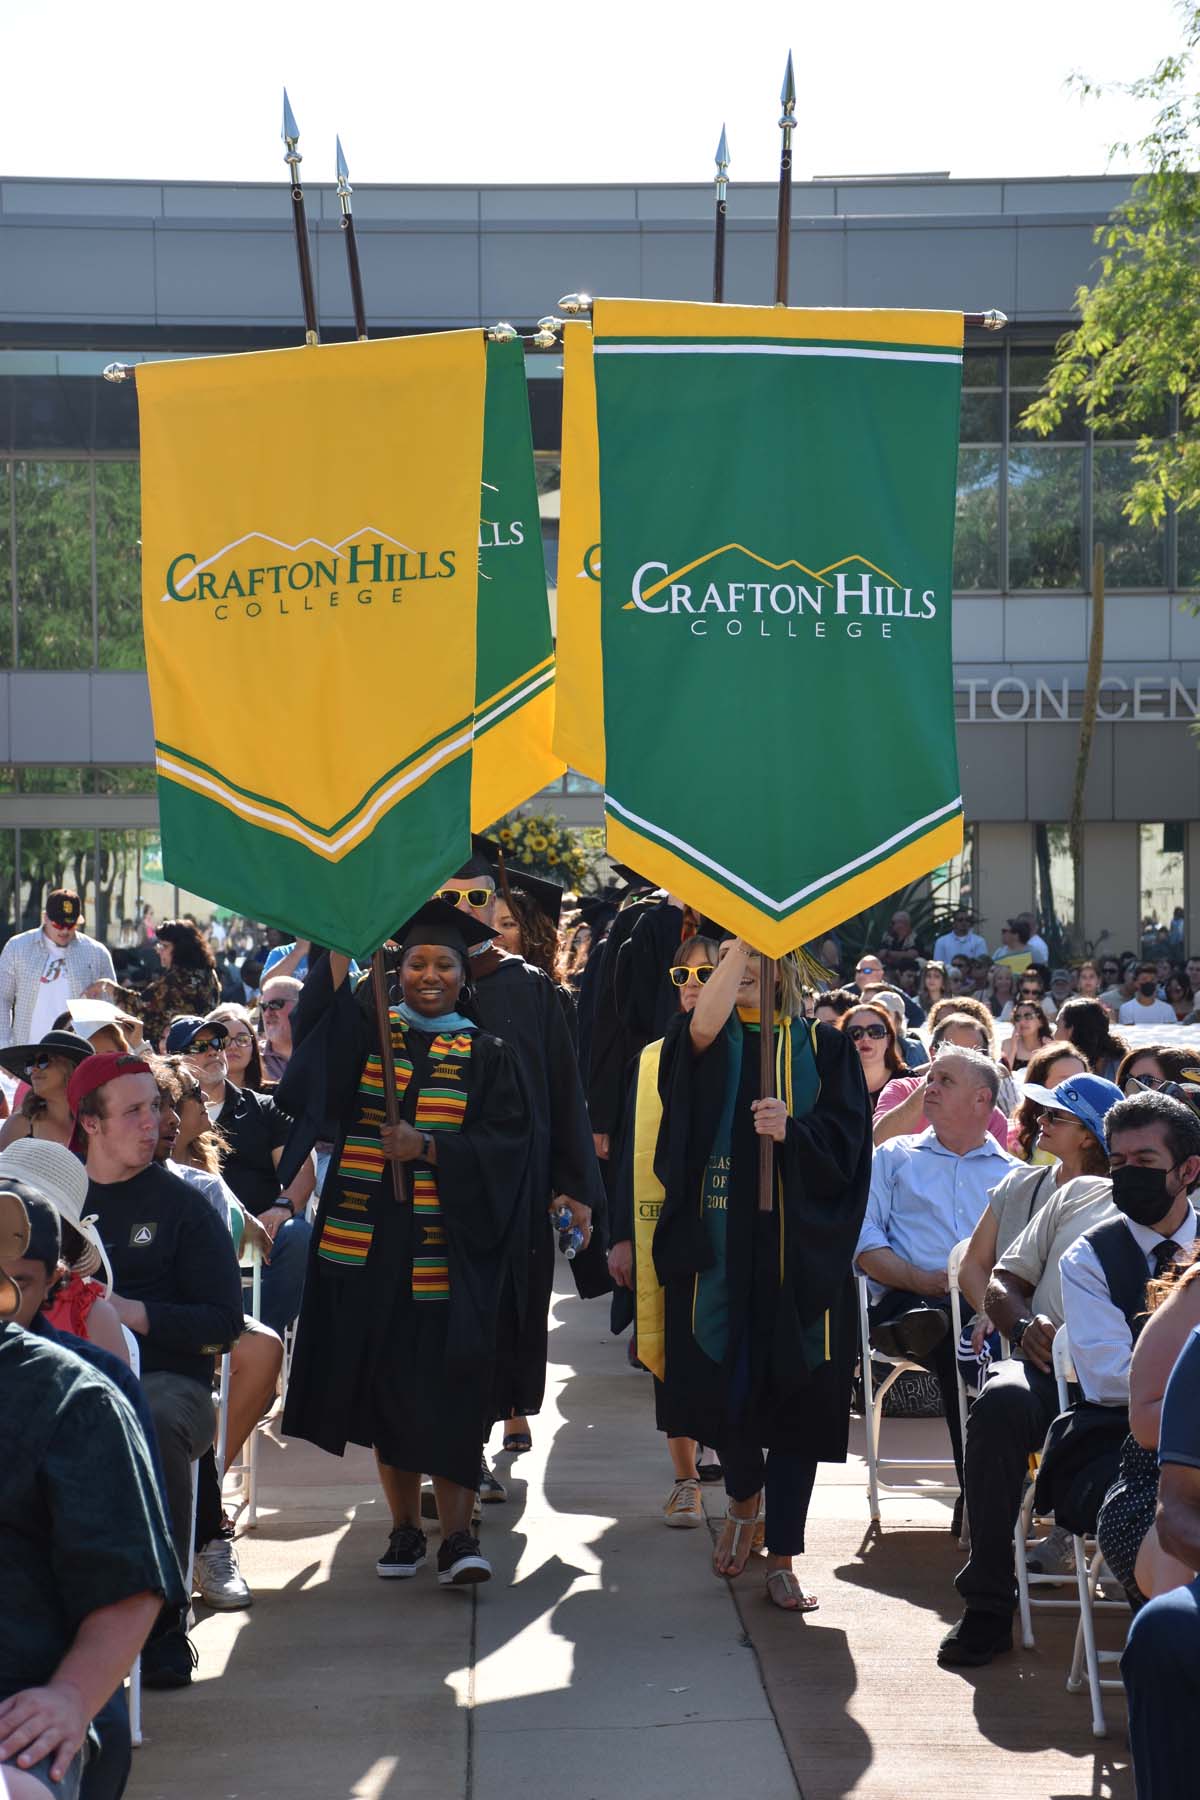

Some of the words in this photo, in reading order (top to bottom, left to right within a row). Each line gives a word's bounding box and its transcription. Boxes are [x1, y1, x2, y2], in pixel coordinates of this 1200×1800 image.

[166, 553, 338, 602] CRAFTON
[347, 543, 456, 584] HILLS
[214, 587, 402, 620] COLLEGE
[631, 561, 825, 614] CRAFTON
[833, 573, 936, 619] HILLS
[691, 619, 891, 638] COLLEGE
[712, 1175, 728, 1188] OF
